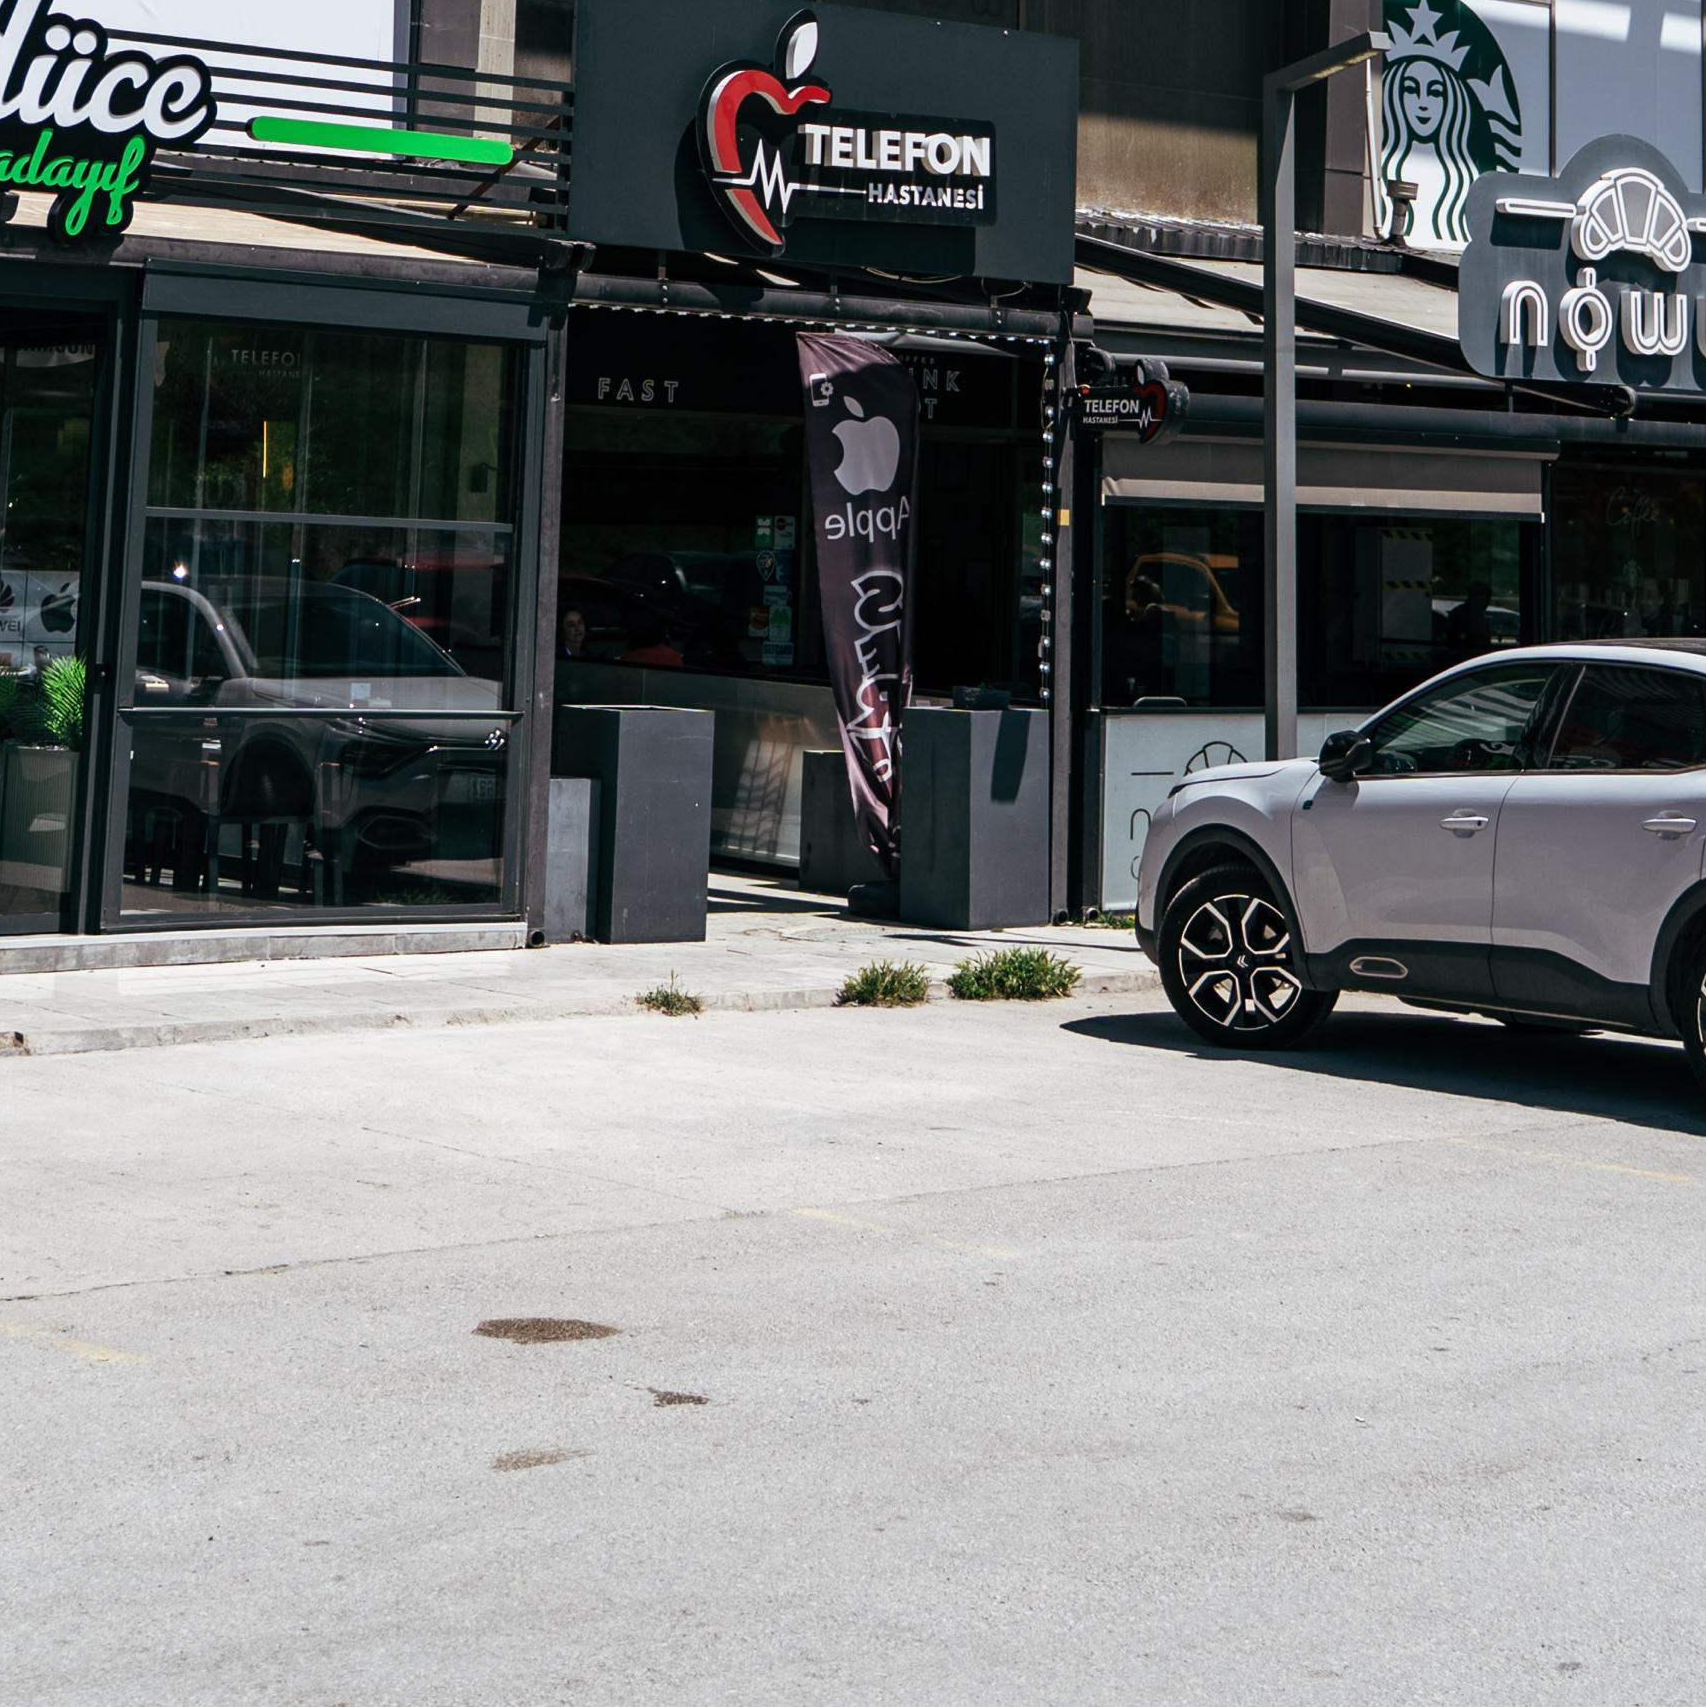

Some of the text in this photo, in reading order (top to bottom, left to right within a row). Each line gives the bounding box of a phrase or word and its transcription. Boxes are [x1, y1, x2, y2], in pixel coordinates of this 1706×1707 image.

[800, 123, 991, 177] TELEFON
[868, 182, 984, 211] HASTANESİ
[598, 377, 680, 403] FAST
[1084, 399, 1139, 414] TELEFON
